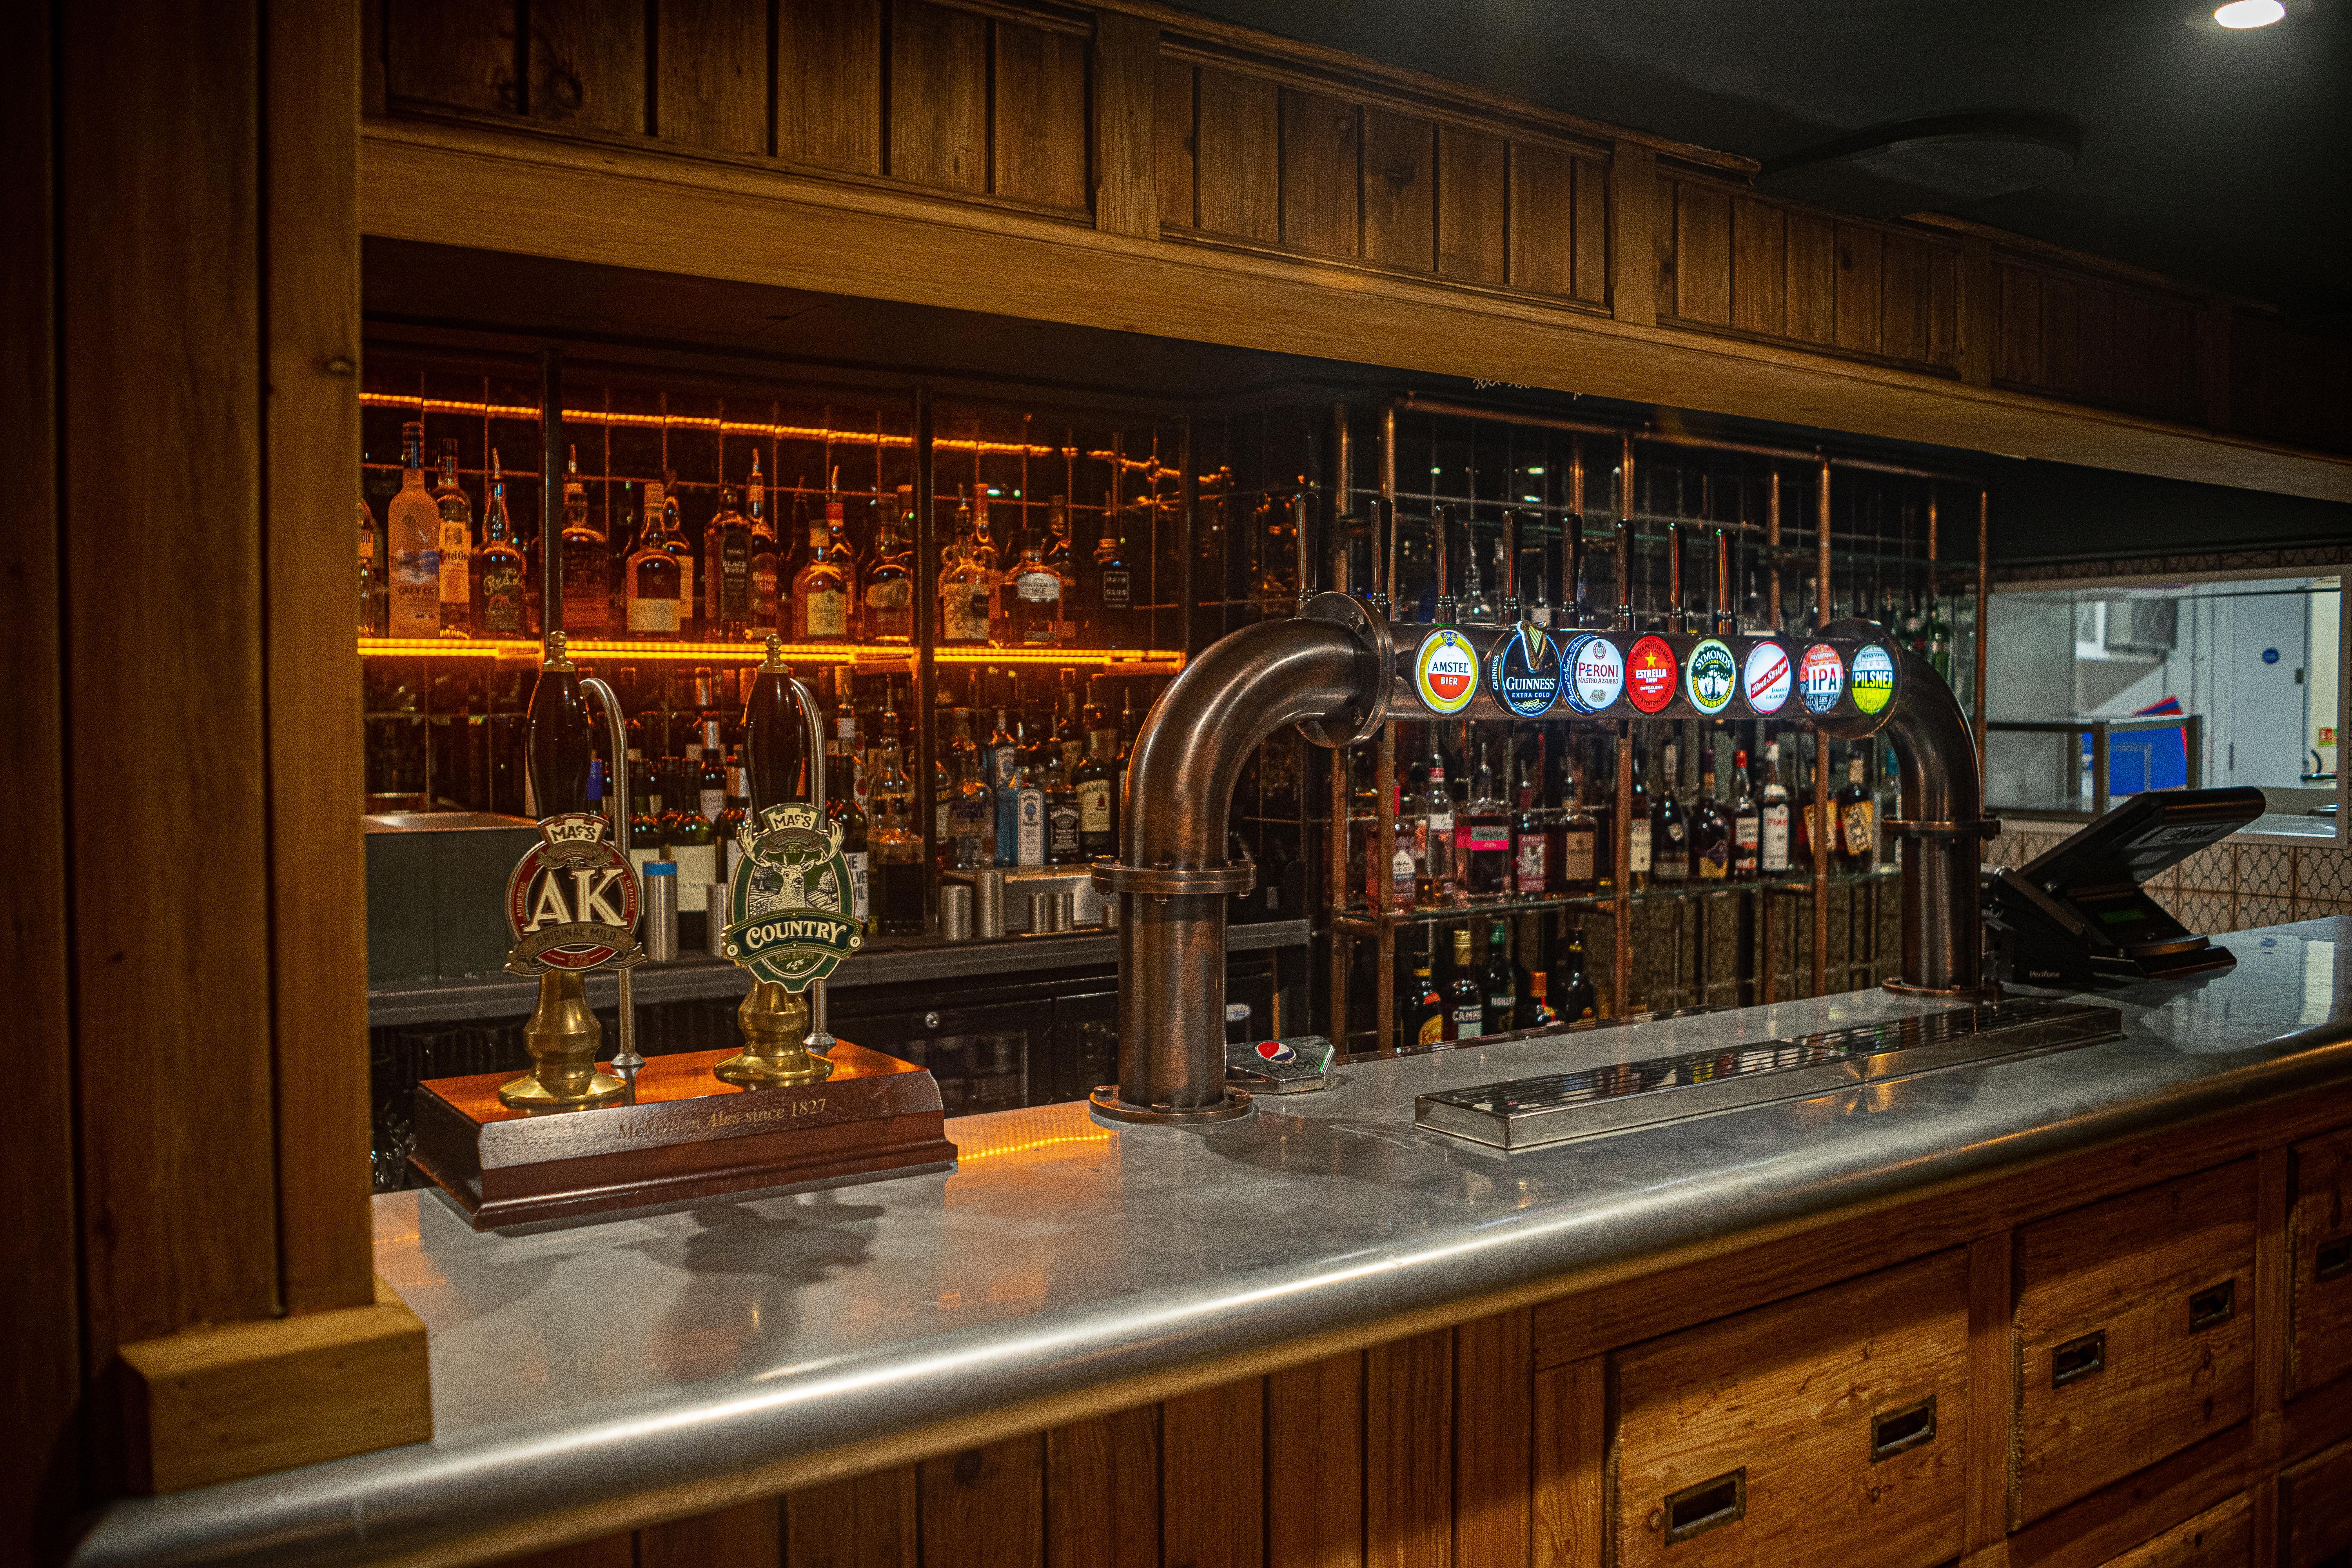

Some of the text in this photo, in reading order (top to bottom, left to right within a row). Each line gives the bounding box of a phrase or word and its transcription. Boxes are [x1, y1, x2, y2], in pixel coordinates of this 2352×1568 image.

[1632, 646, 1645, 666] CERVEZA
[1695, 650, 1731, 670] SYMONDS
[1432, 661, 1468, 673] AMSTEL
[1492, 655, 1500, 691] GUINNESS
[1578, 662, 1619, 677] PERONI
[1635, 668, 1667, 679] ESTRELLA
[1440, 676, 1458, 686] BIER
[1506, 677, 1555, 690] GUINNESS
[1752, 676, 1767, 695] Red
[1766, 660, 1787, 683] Stripe
[1813, 667, 1837, 691] IPA
[1855, 671, 1893, 688] PILSNER
[521, 867, 629, 932] AK
[625, 879, 635, 912] HERITAGE
[536, 927, 617, 946] ORIGINAL MILD
[746, 920, 847, 949] COUNTRY
[1266, 1058, 1320, 1074] pepsi
[706, 1112, 740, 1129] Ales
[745, 1107, 785, 1123] since
[790, 1098, 827, 1118] 1827
